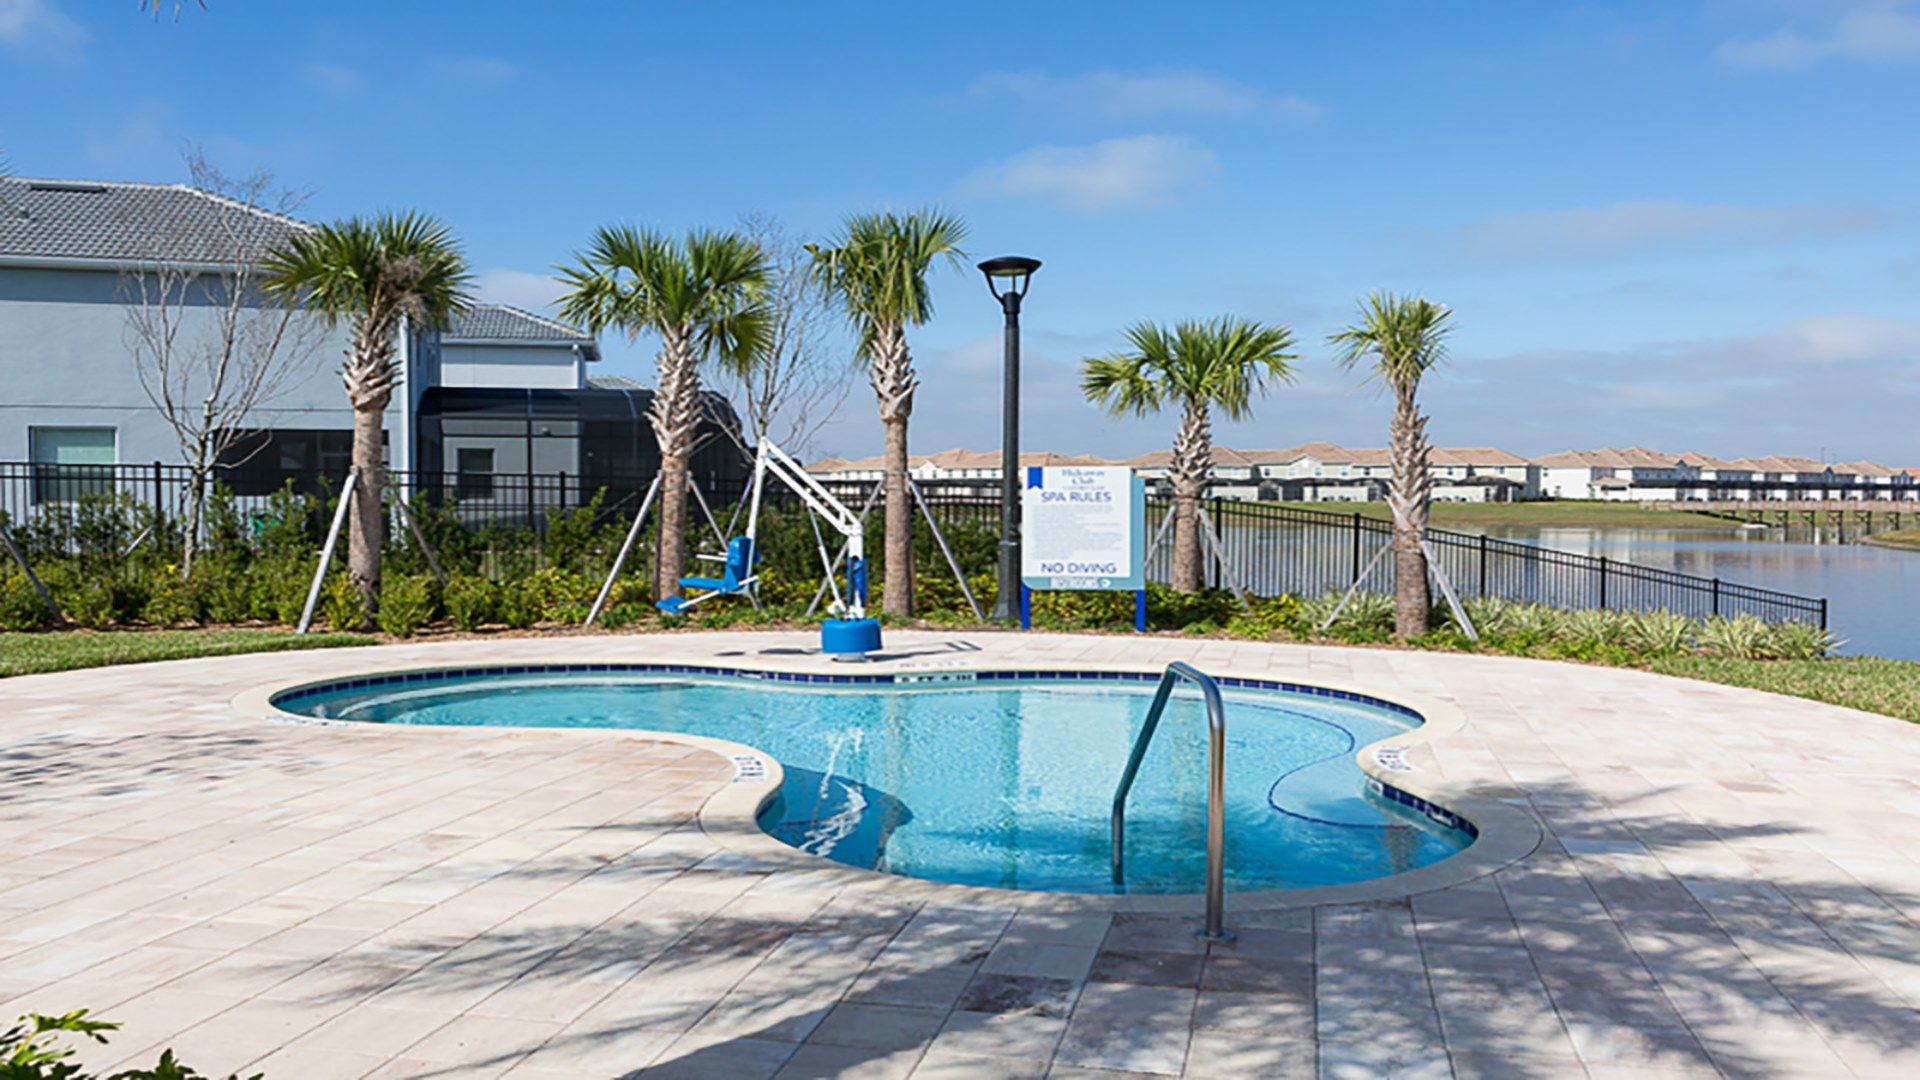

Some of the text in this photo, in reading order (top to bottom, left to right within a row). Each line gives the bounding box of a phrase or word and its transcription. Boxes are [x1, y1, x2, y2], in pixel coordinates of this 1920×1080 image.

[1041, 491, 1112, 502] SPA RULES
[1041, 562, 1117, 573] NO DIVING
